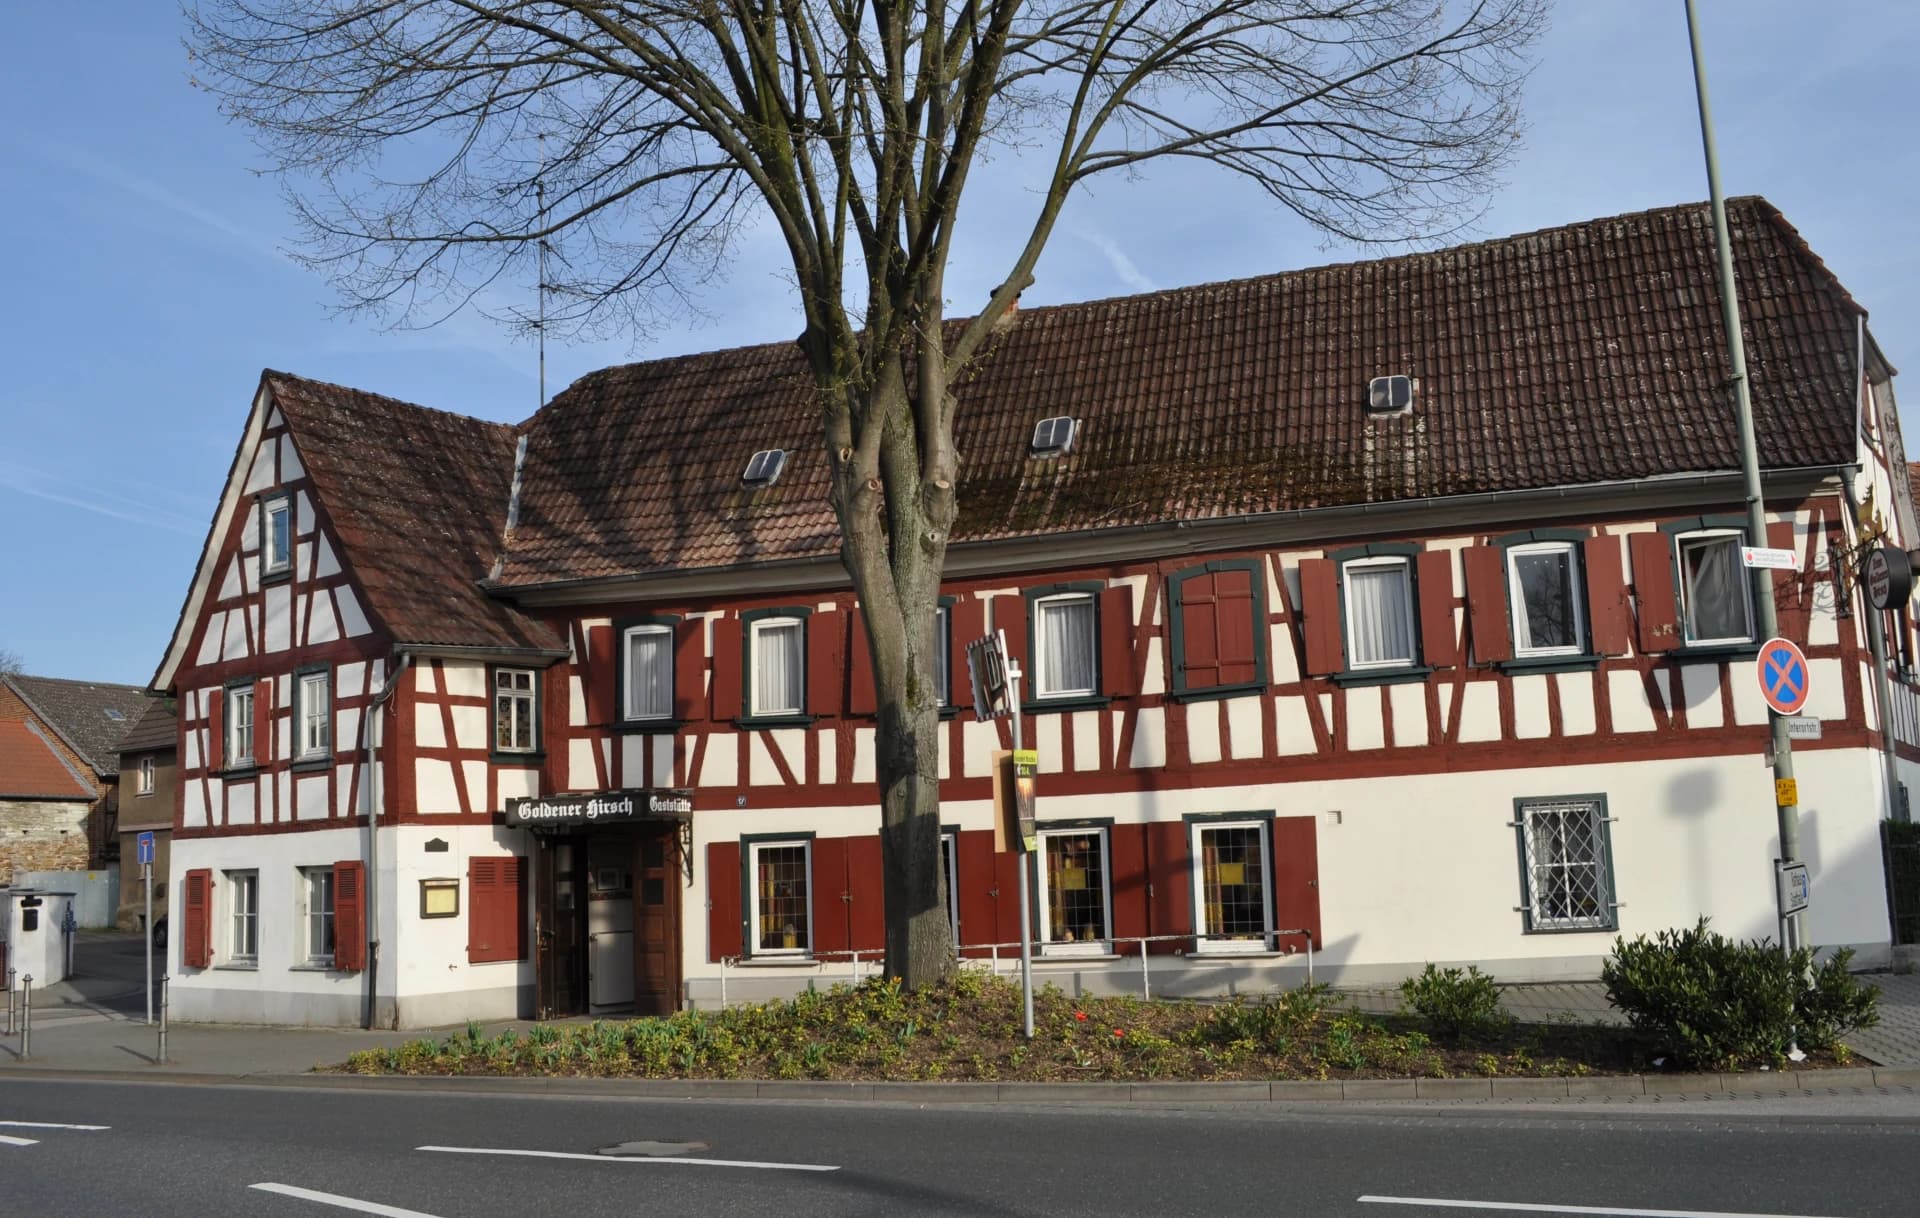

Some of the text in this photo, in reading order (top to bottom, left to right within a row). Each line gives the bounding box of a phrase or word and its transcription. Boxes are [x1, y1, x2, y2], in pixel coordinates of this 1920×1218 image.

[518, 797, 633, 819] Goldener Hirsch
[650, 796, 692, 812] Gaststätte
